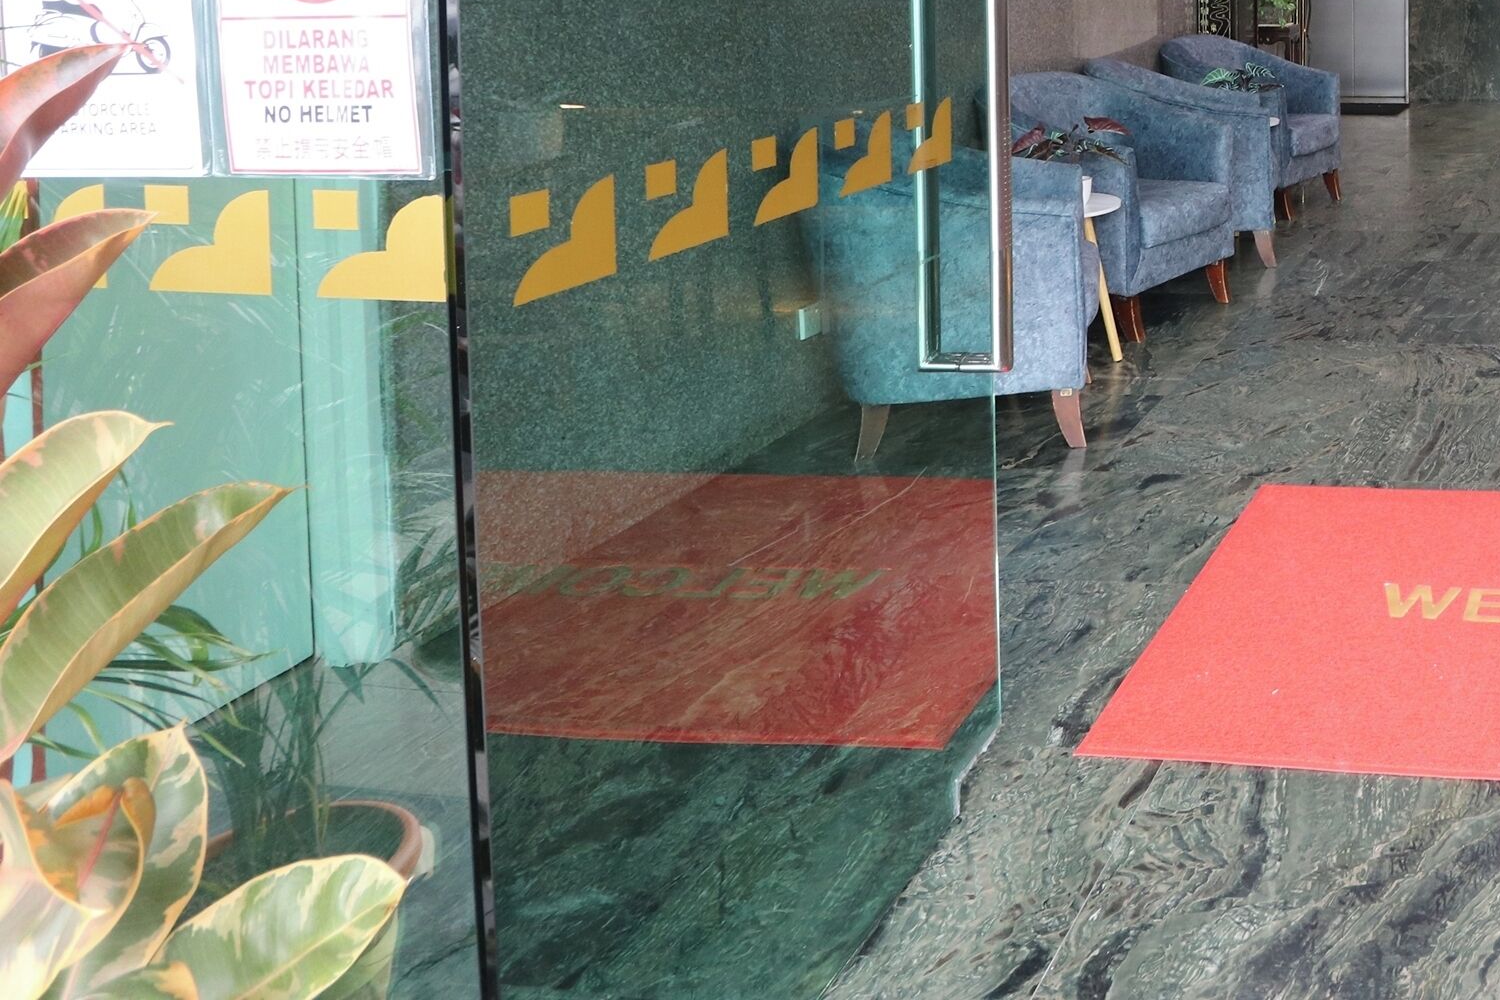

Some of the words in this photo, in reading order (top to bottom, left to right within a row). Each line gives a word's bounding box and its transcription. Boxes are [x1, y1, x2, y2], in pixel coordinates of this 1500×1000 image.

[263, 29, 369, 49] DILARANG
[263, 55, 370, 74] MEMBAWA
[244, 80, 293, 99] TOPI
[303, 79, 395, 99] KELEDAR
[264, 105, 291, 123] NO
[300, 105, 373, 123] HELMET
[60, 122, 114, 136] ARKING
